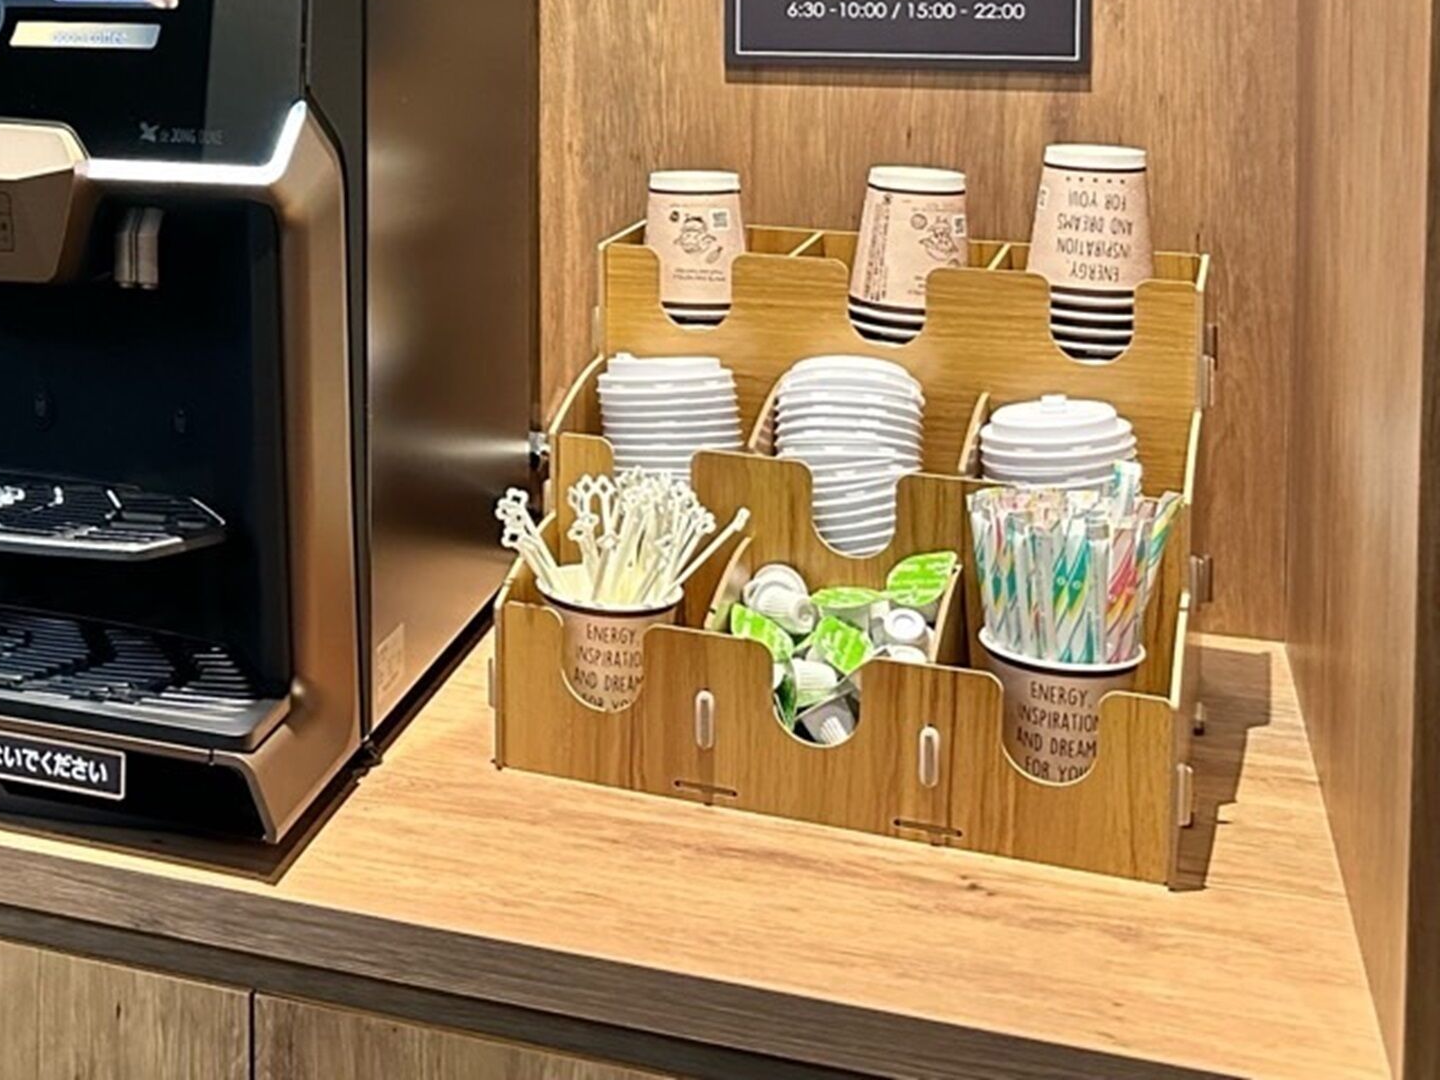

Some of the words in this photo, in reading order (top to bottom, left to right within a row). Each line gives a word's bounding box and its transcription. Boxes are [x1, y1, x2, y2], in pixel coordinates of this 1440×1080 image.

[786, 1, 826, 19] 6:30
[907, 1, 956, 19] 15:00
[974, 1, 1025, 19] 22:00
[1104, 193, 1127, 212] FOR
[1056, 212, 1104, 233] DREAMS
[1109, 216, 1133, 235] AND
[1056, 237, 1132, 259] INSPIRATION
[576, 644, 643, 669] INSPIRATIO
[574, 666, 598, 689] AND
[1016, 726, 1043, 752] AND
[1050, 736, 1097, 758] DREAM
[1025, 756, 1050, 778] FOR
